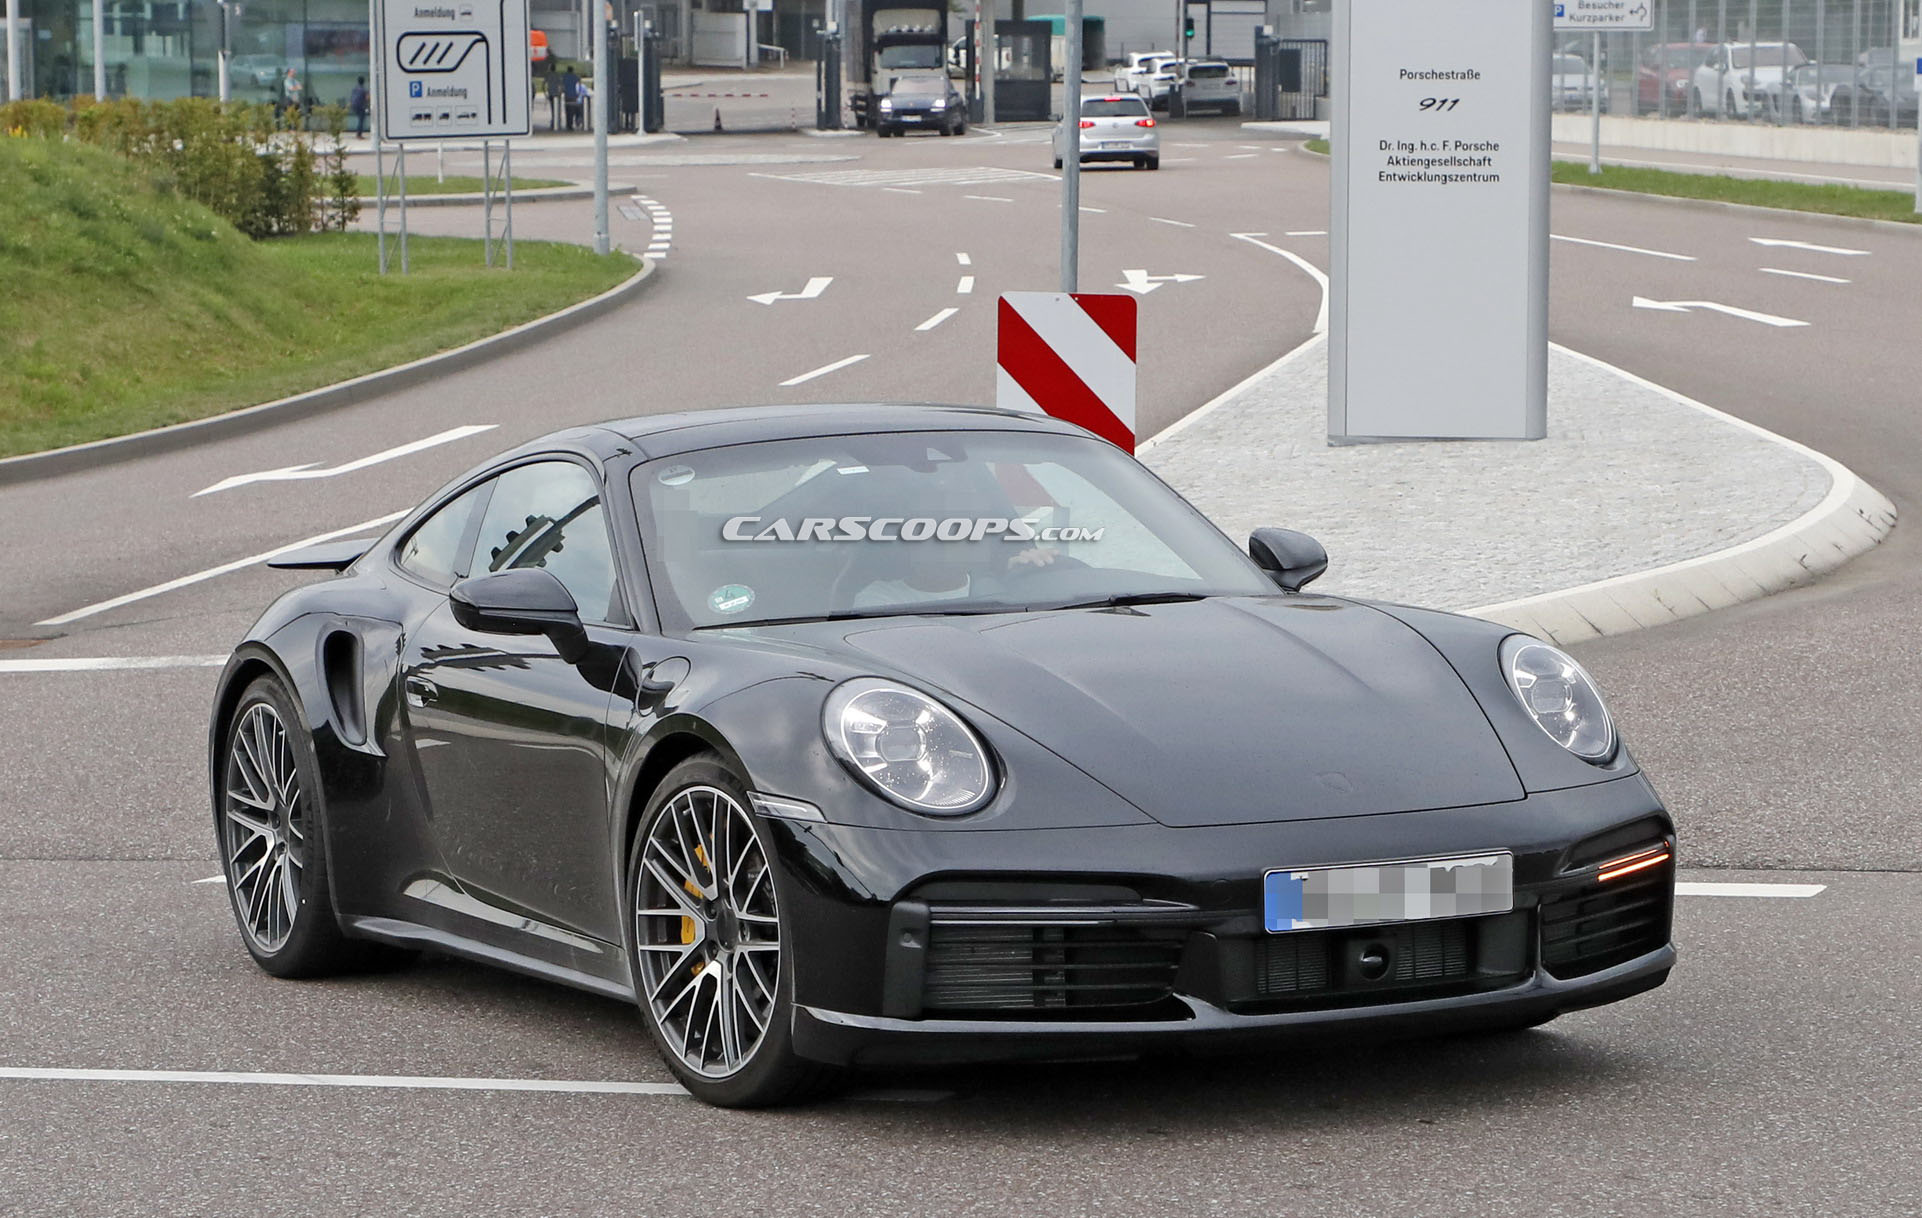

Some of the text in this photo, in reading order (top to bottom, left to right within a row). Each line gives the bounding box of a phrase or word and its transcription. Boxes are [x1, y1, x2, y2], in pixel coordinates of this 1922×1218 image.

[1578, 0, 1624, 9] Besucher
[414, 7, 455, 21] Anmeldung
[1569, 14, 1624, 23] Kurzparker
[1399, 69, 1481, 80] Porschestraße
[426, 86, 467, 100] Anmeldung
[1419, 97, 1460, 112] 911
[1379, 140, 1500, 154] Dr. Ing. h.c. F. Porsche
[1387, 155, 1492, 170] Aktiengesellschaft
[1378, 171, 1500, 185] Entwicklungszentrum
